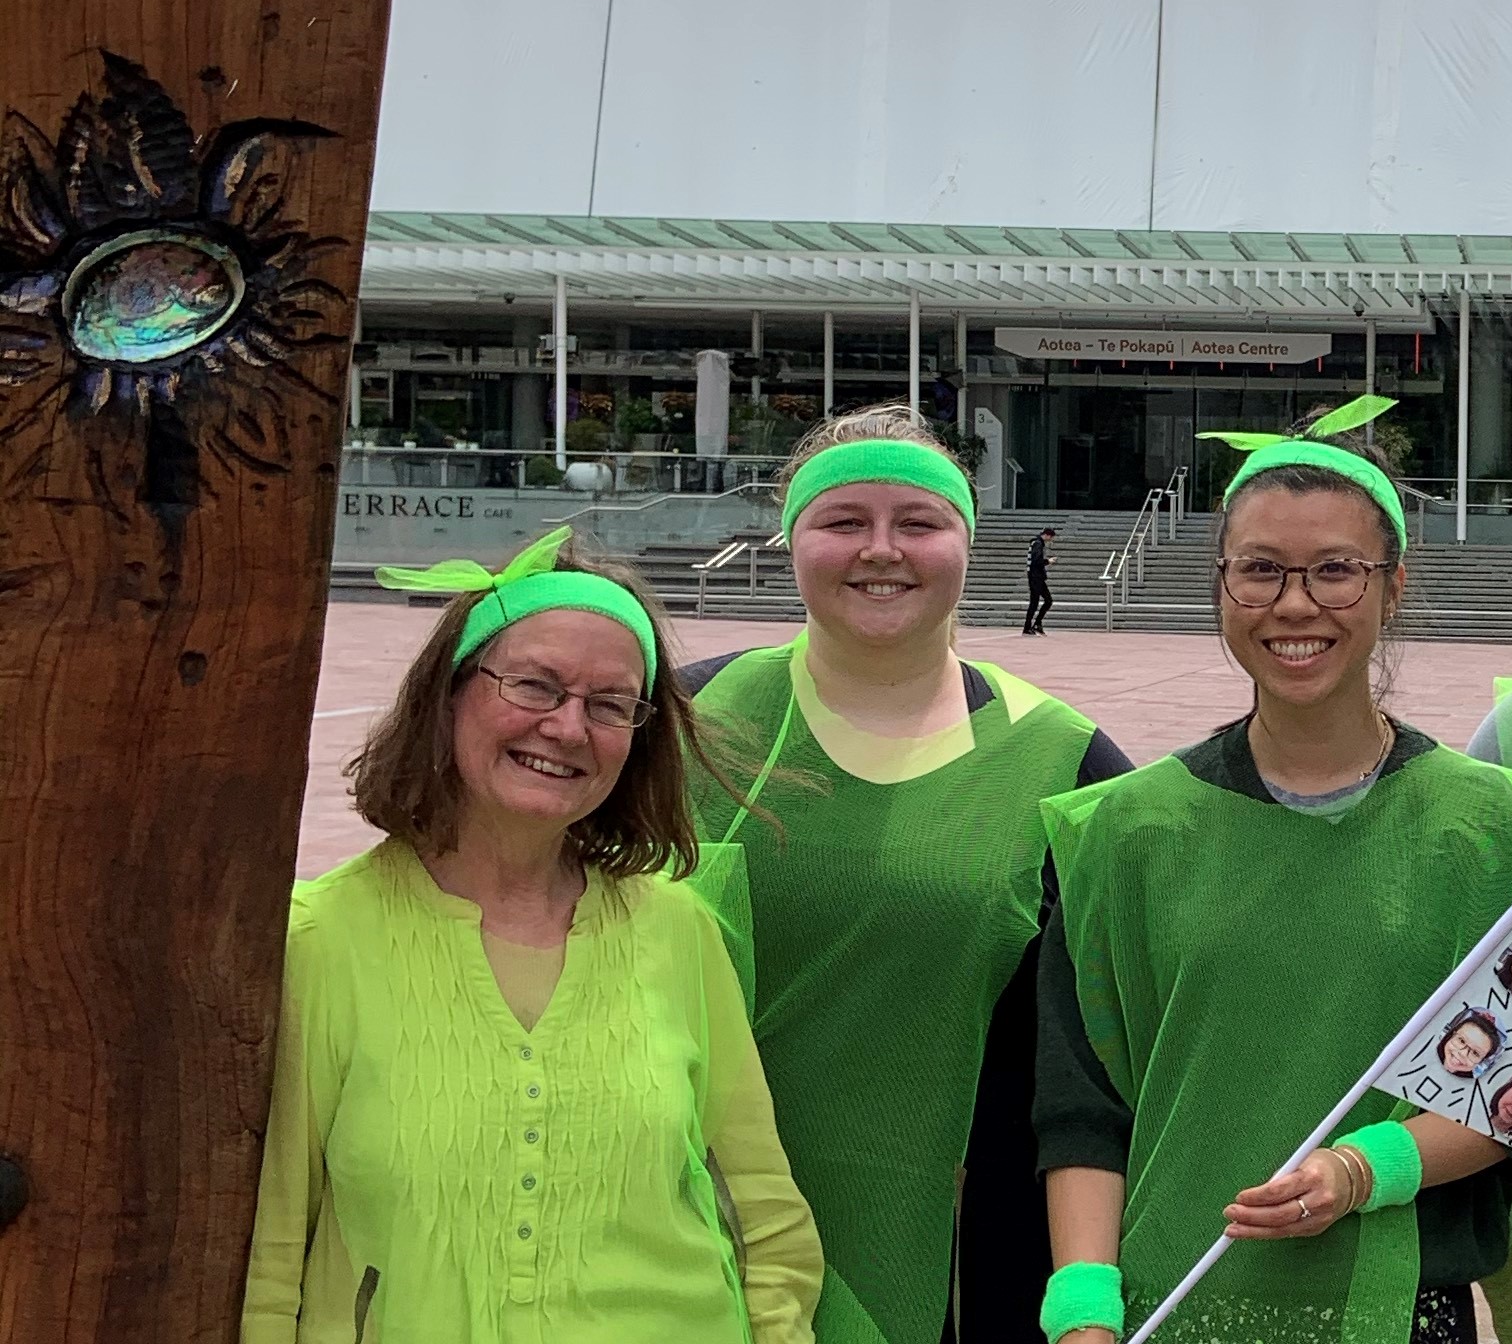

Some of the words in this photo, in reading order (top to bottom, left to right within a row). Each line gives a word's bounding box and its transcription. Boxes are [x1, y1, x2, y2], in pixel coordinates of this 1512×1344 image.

[1037, 338, 1081, 352] Aotea
[1098, 339, 1116, 352] Te
[1191, 340, 1234, 354] Aotea
[1238, 341, 1289, 356] Centre
[978, 413, 985, 424] 3
[343, 493, 474, 518] ERRACE
